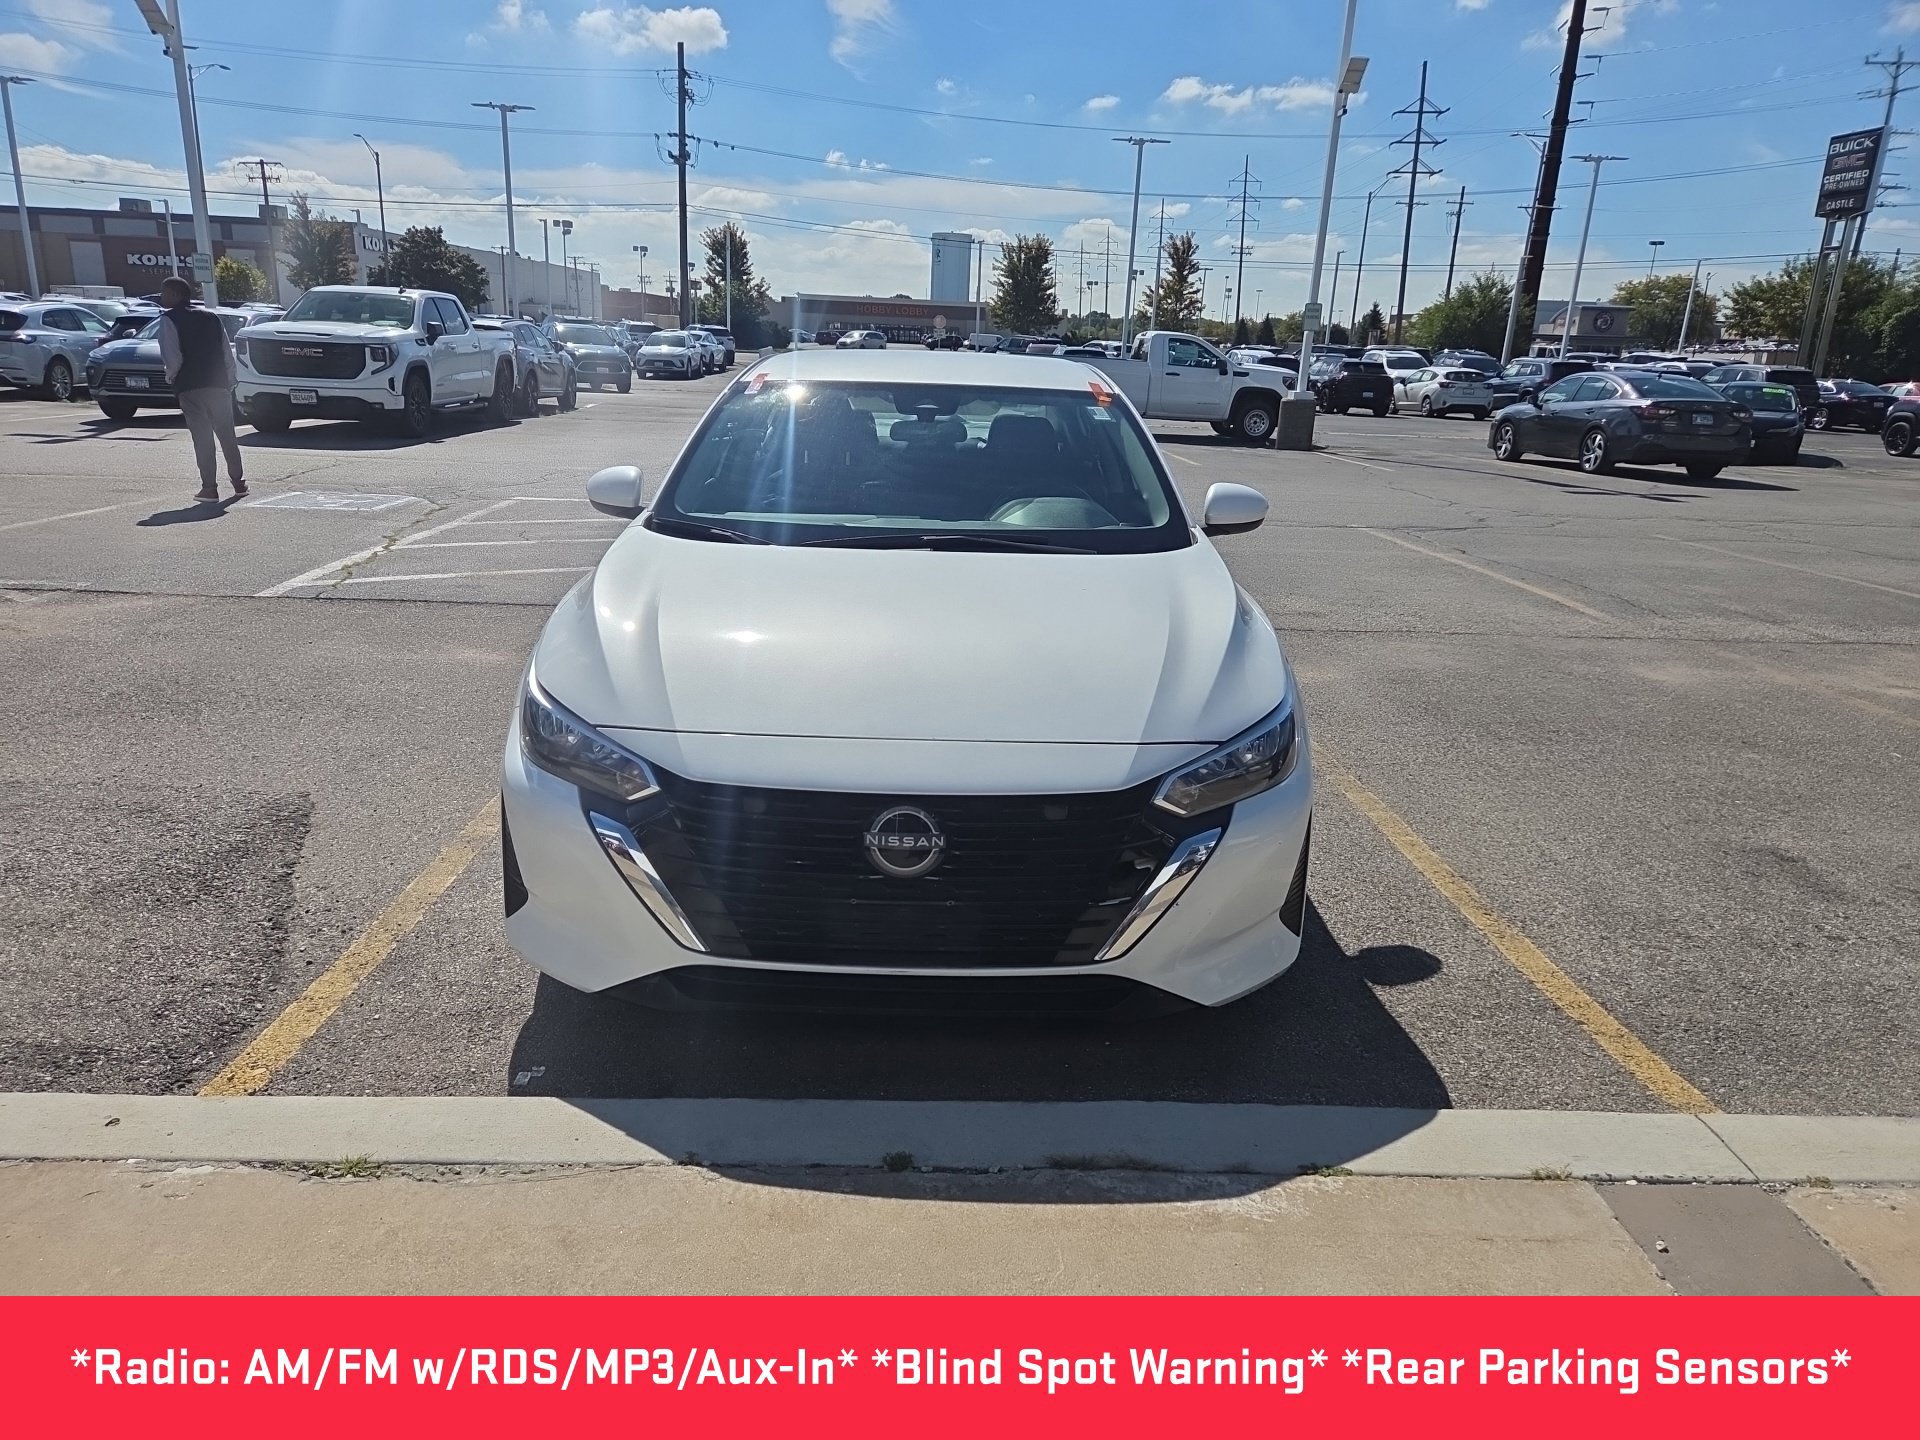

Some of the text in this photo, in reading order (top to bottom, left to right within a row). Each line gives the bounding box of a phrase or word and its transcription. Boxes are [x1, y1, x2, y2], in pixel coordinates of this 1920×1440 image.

[1829, 136, 1877, 154] BUICK
[1832, 152, 1867, 170] GMC
[1823, 169, 1870, 183] CERTIFIED
[1824, 178, 1865, 191] PRE-OWNED
[1826, 198, 1855, 210] CASTLE
[148, 268, 189, 276] SEPHRA
[856, 304, 929, 316] HOBBY LOBBY
[281, 346, 324, 357] GMC
[866, 834, 944, 847] NISSAN
